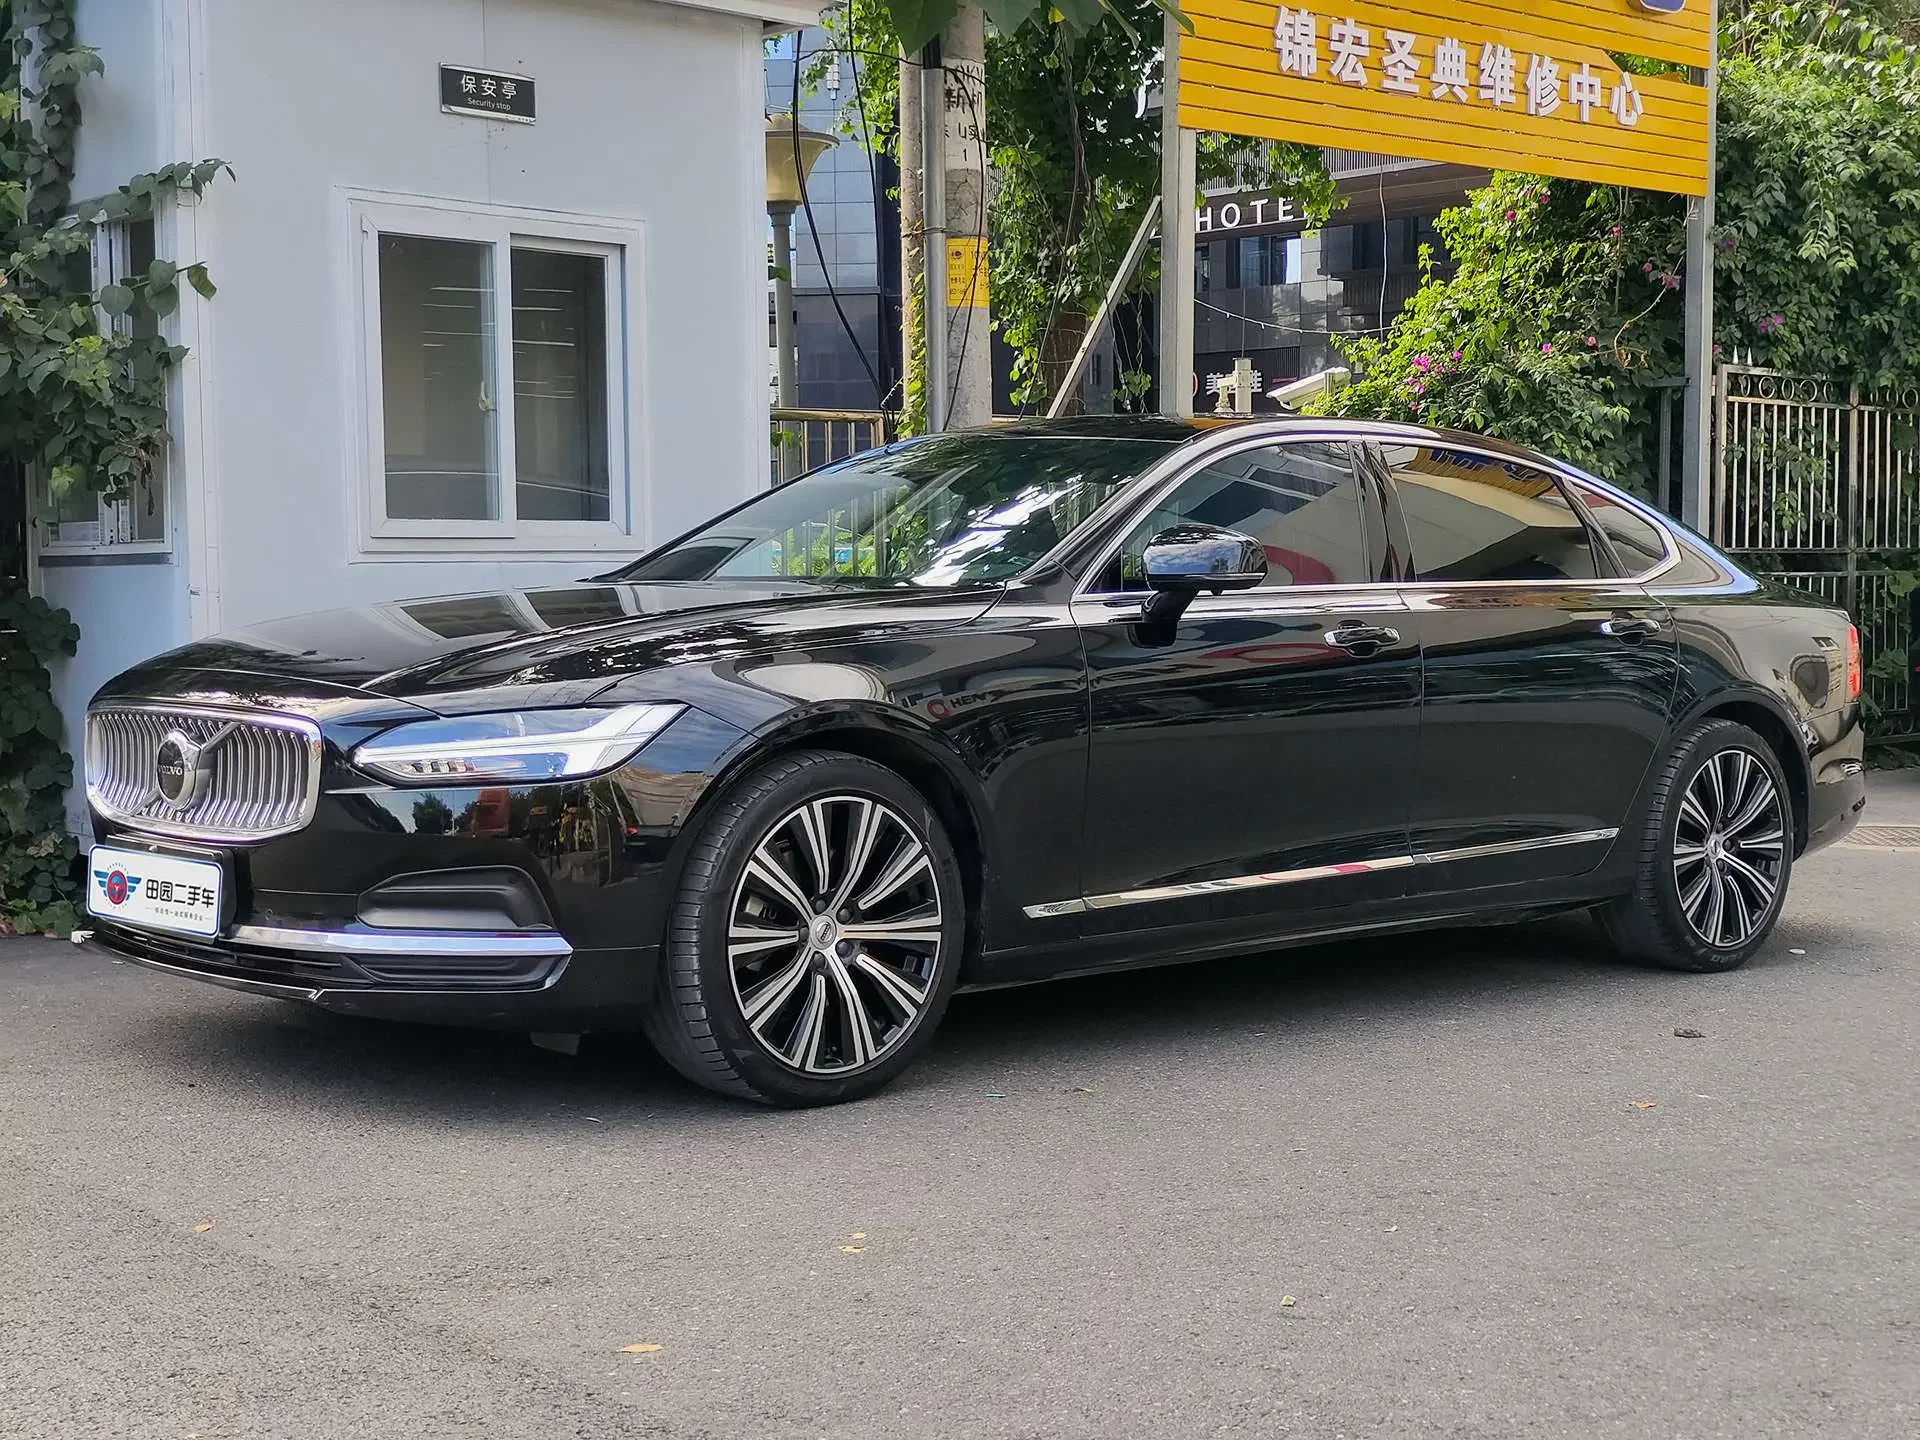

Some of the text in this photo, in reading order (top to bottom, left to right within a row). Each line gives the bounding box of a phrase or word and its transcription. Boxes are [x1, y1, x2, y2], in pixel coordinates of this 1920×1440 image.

[1273, 5, 1643, 126] 锦宏圣典维修中心
[461, 74, 517, 99] 保安亭
[467, 97, 511, 111] Security stop
[146, 879, 215, 908] 田园二手车
